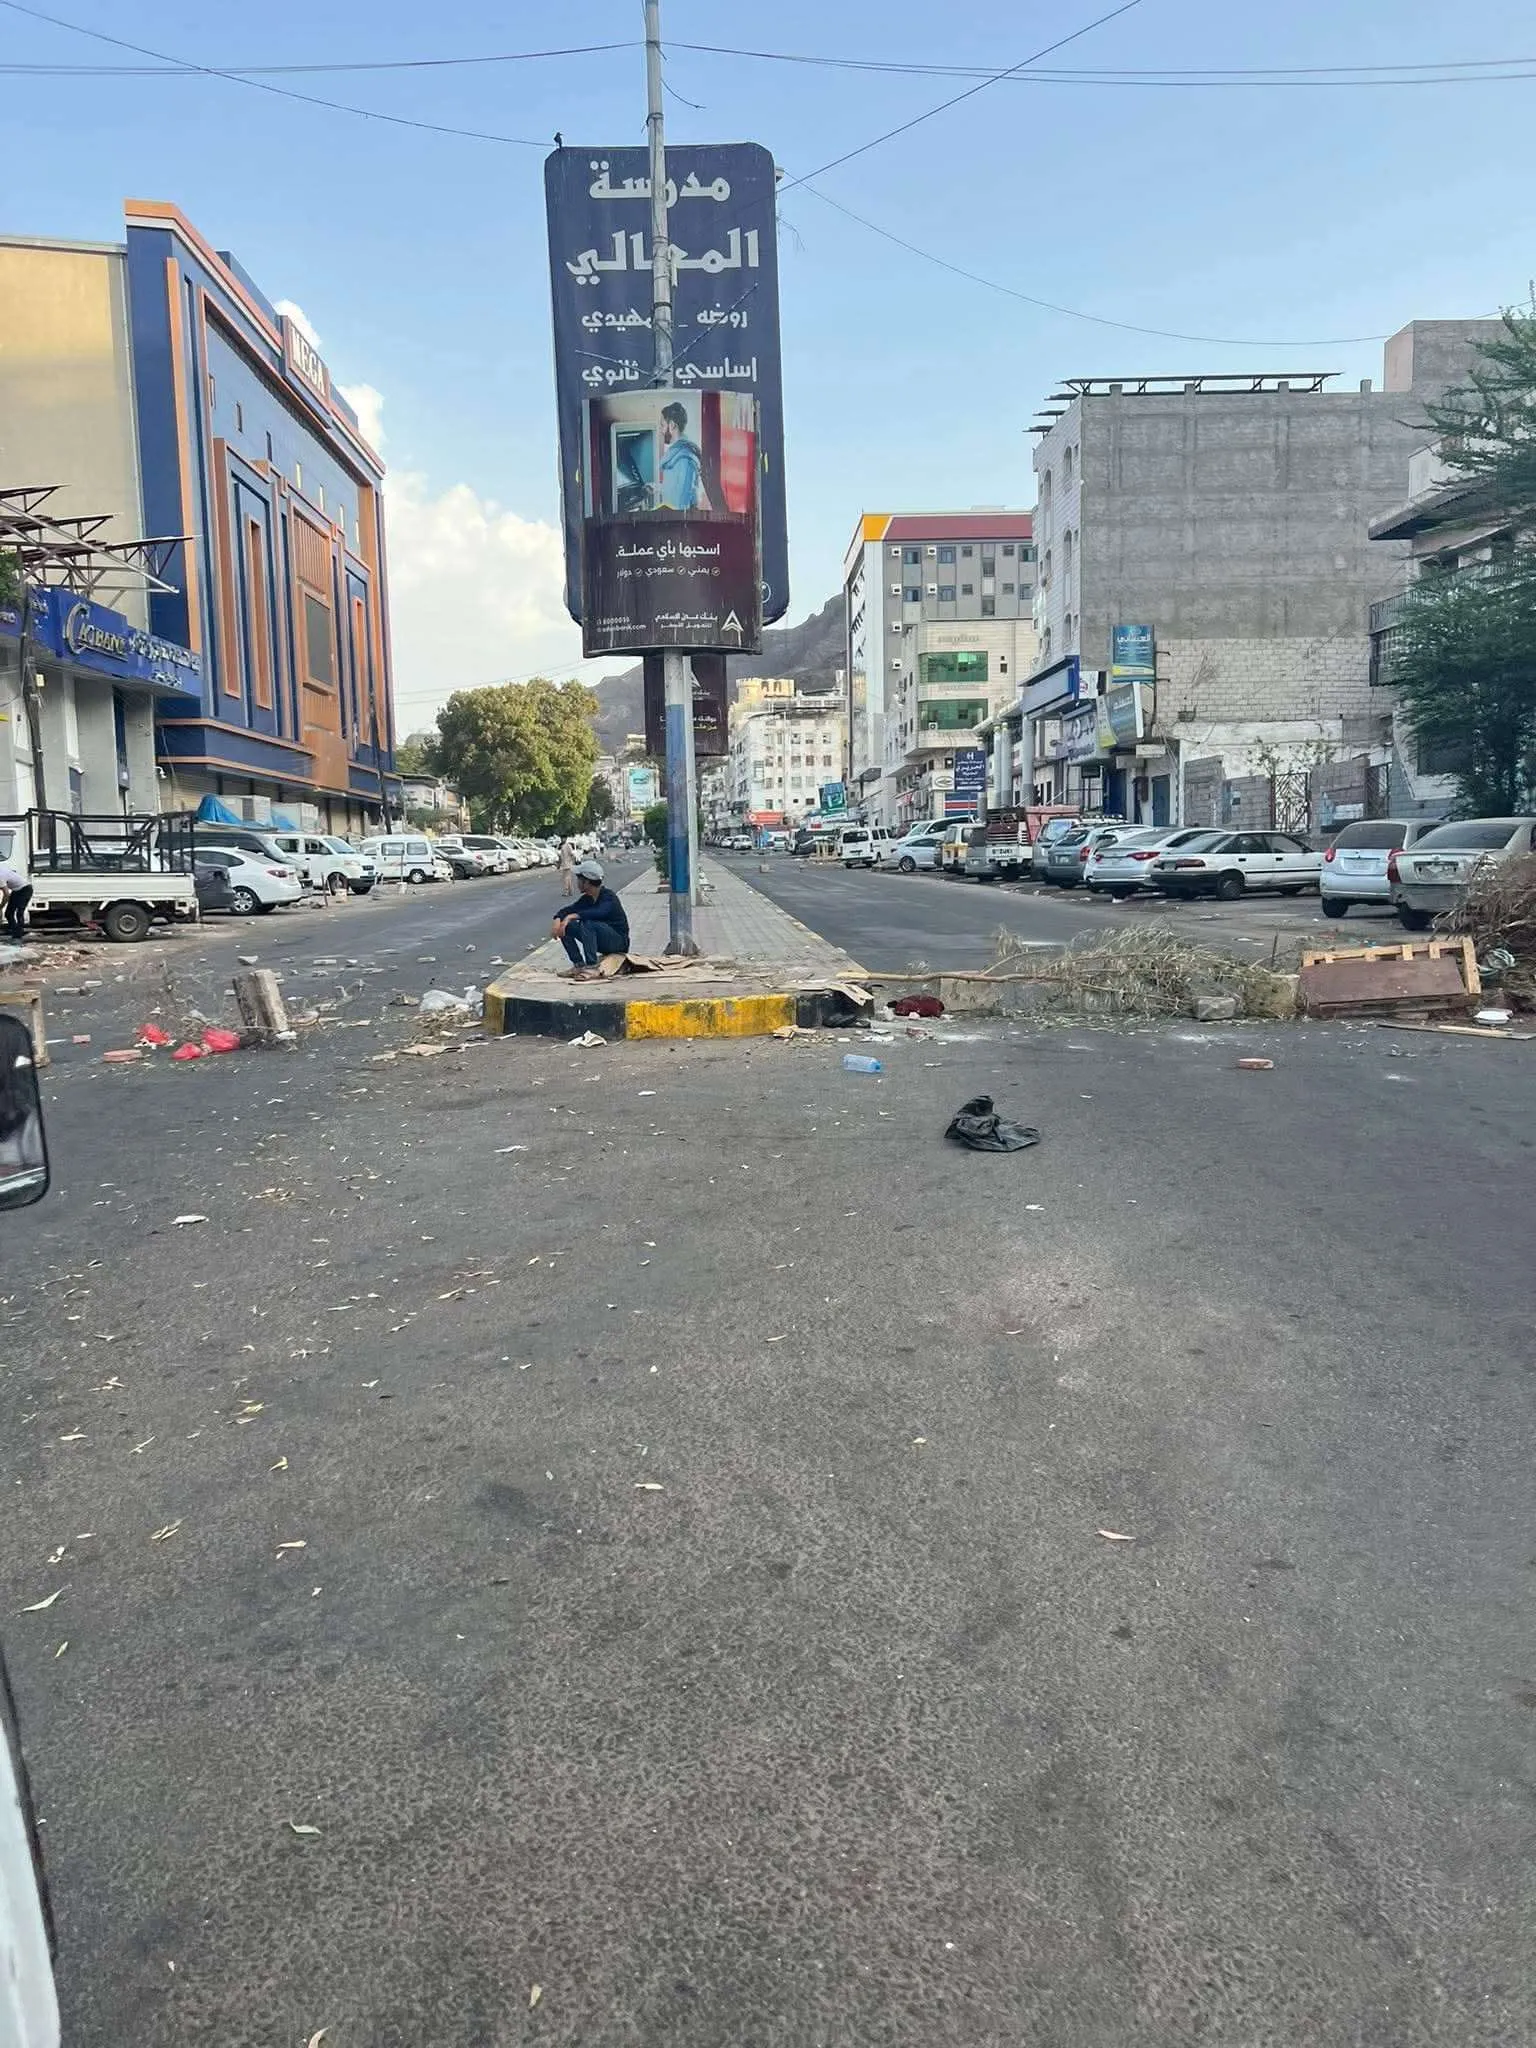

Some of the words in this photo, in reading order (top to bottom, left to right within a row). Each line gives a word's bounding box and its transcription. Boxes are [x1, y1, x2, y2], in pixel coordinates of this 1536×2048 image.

[590, 161, 731, 208] مدرسة
[582, 308, 652, 332] مهيدي
[582, 359, 640, 387] ثانوي
[676, 357, 757, 385] اساسي
[656, 539, 676, 561] بأي
[679, 542, 720, 557] اسحبها
[645, 567, 675, 578] سعودي
[687, 565, 710, 578] يمني
